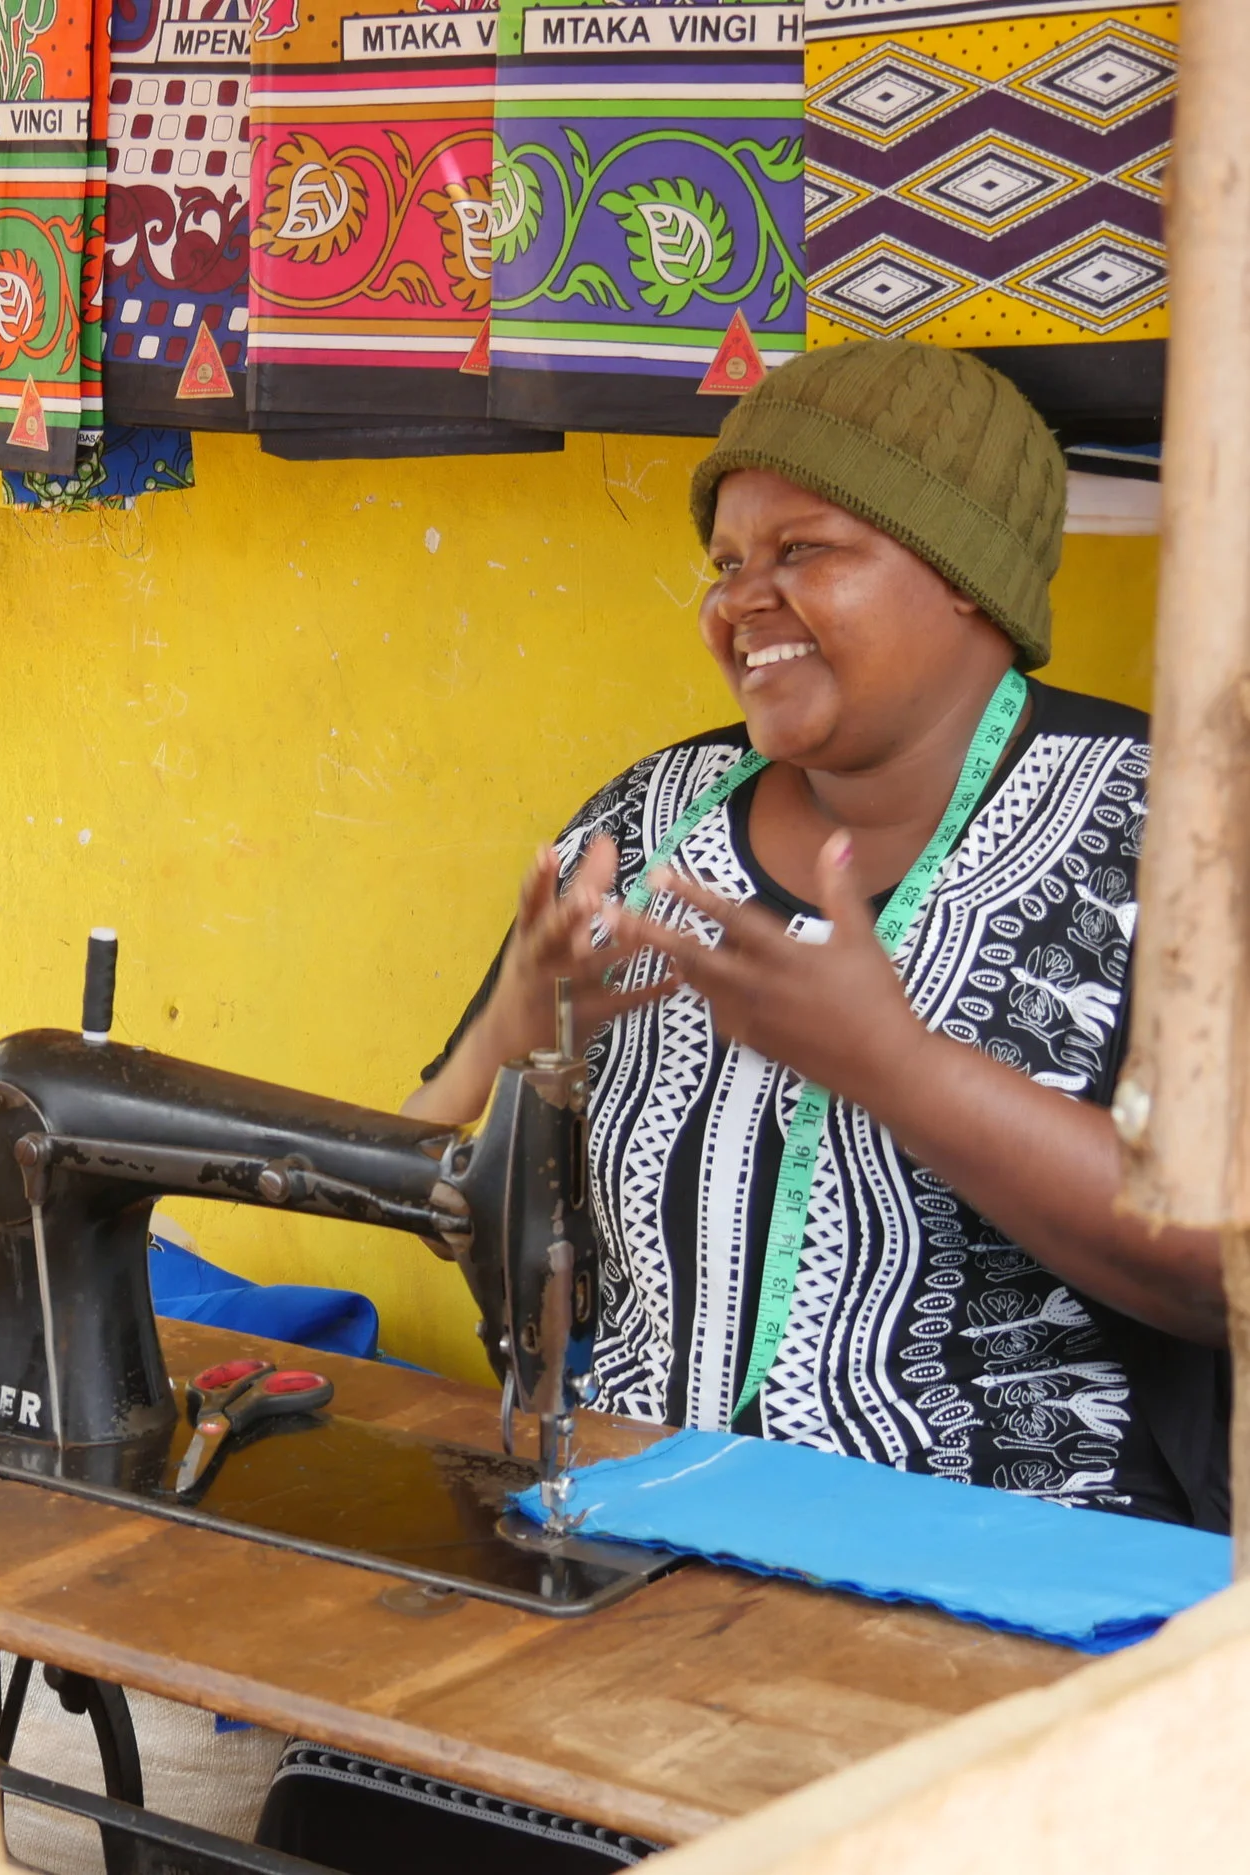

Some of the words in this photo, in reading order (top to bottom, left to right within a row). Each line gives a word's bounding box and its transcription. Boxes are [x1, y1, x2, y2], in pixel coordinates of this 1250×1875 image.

[362, 22, 461, 52] MTAKA
[543, 16, 650, 45] MTAKA
[669, 15, 756, 43] VINGI
[777, 14, 805, 42] H
[10, 109, 62, 134] VINGI
[1000, 697, 1017, 717] 29
[985, 724, 1005, 746] 28
[971, 757, 991, 780] 27
[955, 792, 975, 812] 26
[938, 824, 957, 843] 25
[918, 853, 939, 873] 24
[900, 886, 920, 908] 23
[881, 919, 903, 942] 22
[802, 1101, 821, 1128] 17
[792, 1145, 811, 1171] 16
[785, 1189, 804, 1215] 15
[778, 1232, 797, 1259] 14
[771, 1276, 788, 1302] 13
[764, 1321, 780, 1346] 12
